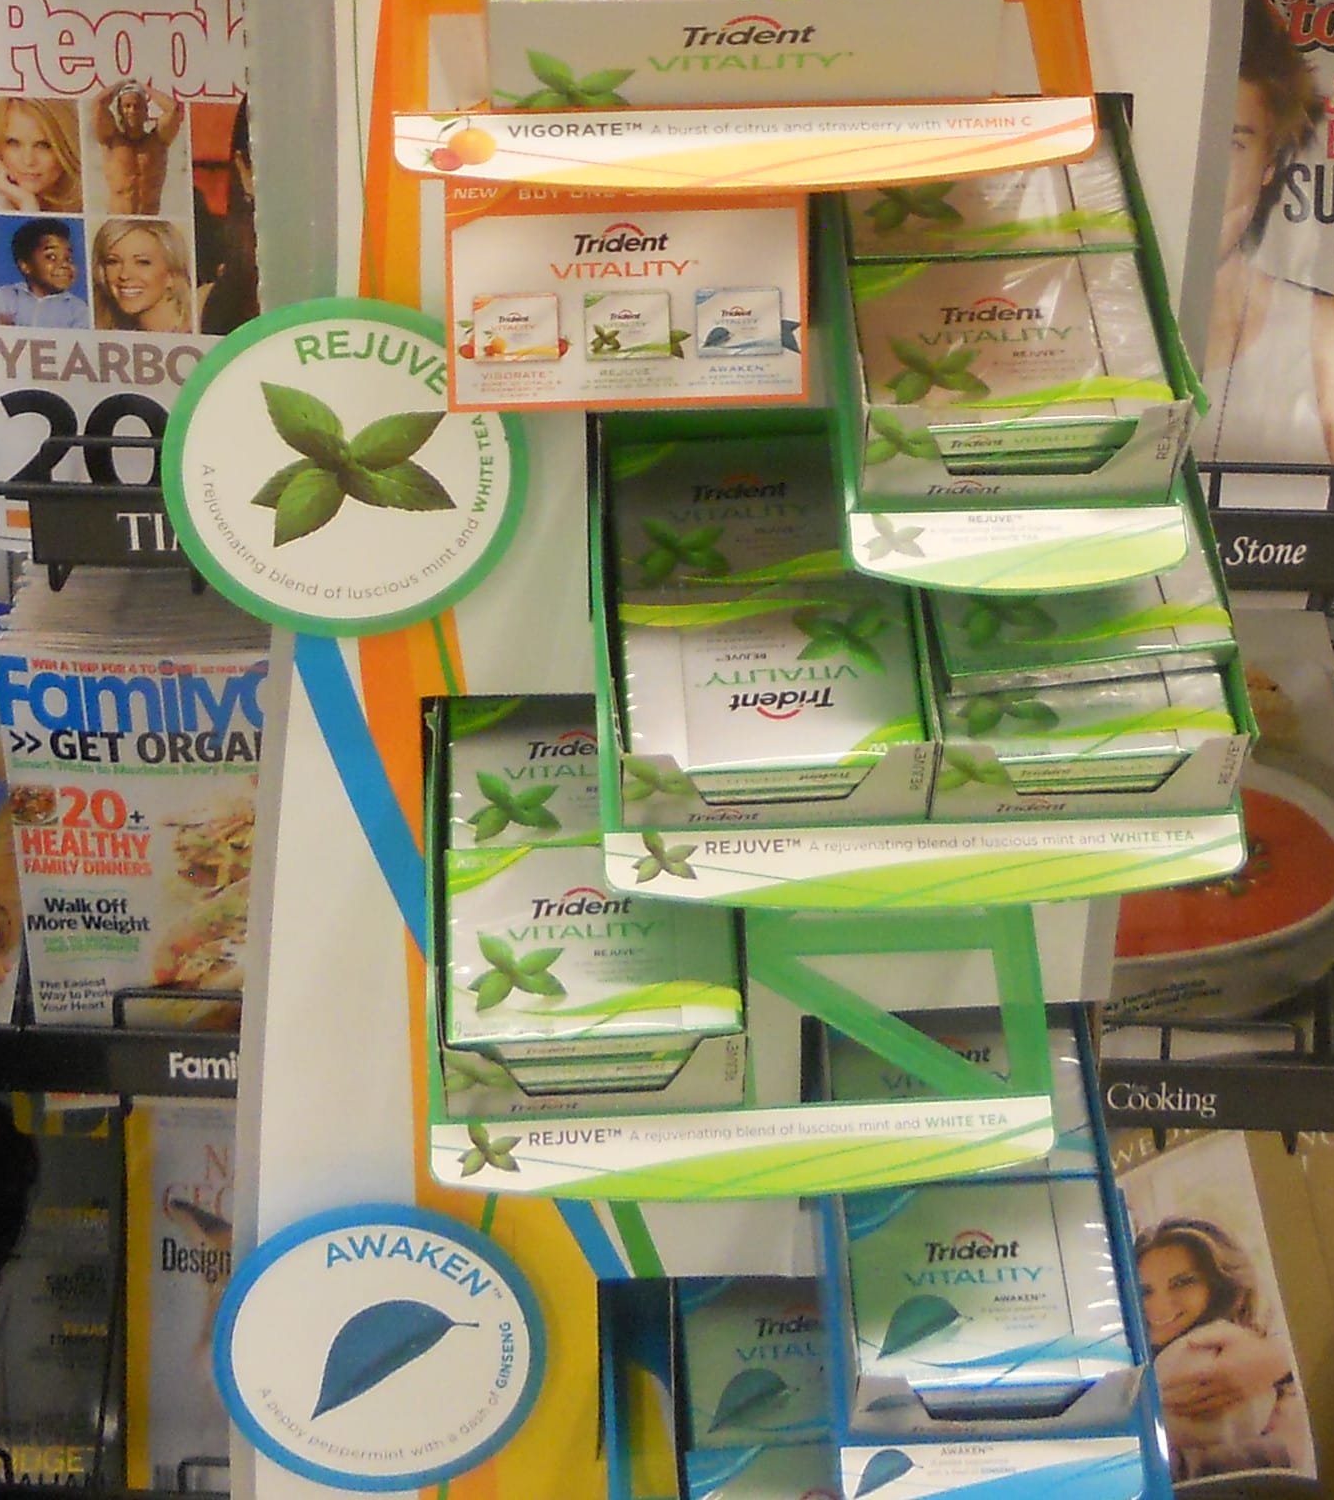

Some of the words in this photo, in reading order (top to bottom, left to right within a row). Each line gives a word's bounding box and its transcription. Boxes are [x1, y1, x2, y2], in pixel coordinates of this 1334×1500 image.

[1225, 536, 1307, 565] Stone
[50, 730, 125, 762] GET
[20, 829, 151, 859] HEALTHY
[44, 898, 91, 914] Walk
[96, 898, 127, 914] Off
[27, 915, 77, 932] More
[85, 916, 151, 934] Weight
[1106, 1084, 1216, 1116] Cooking
